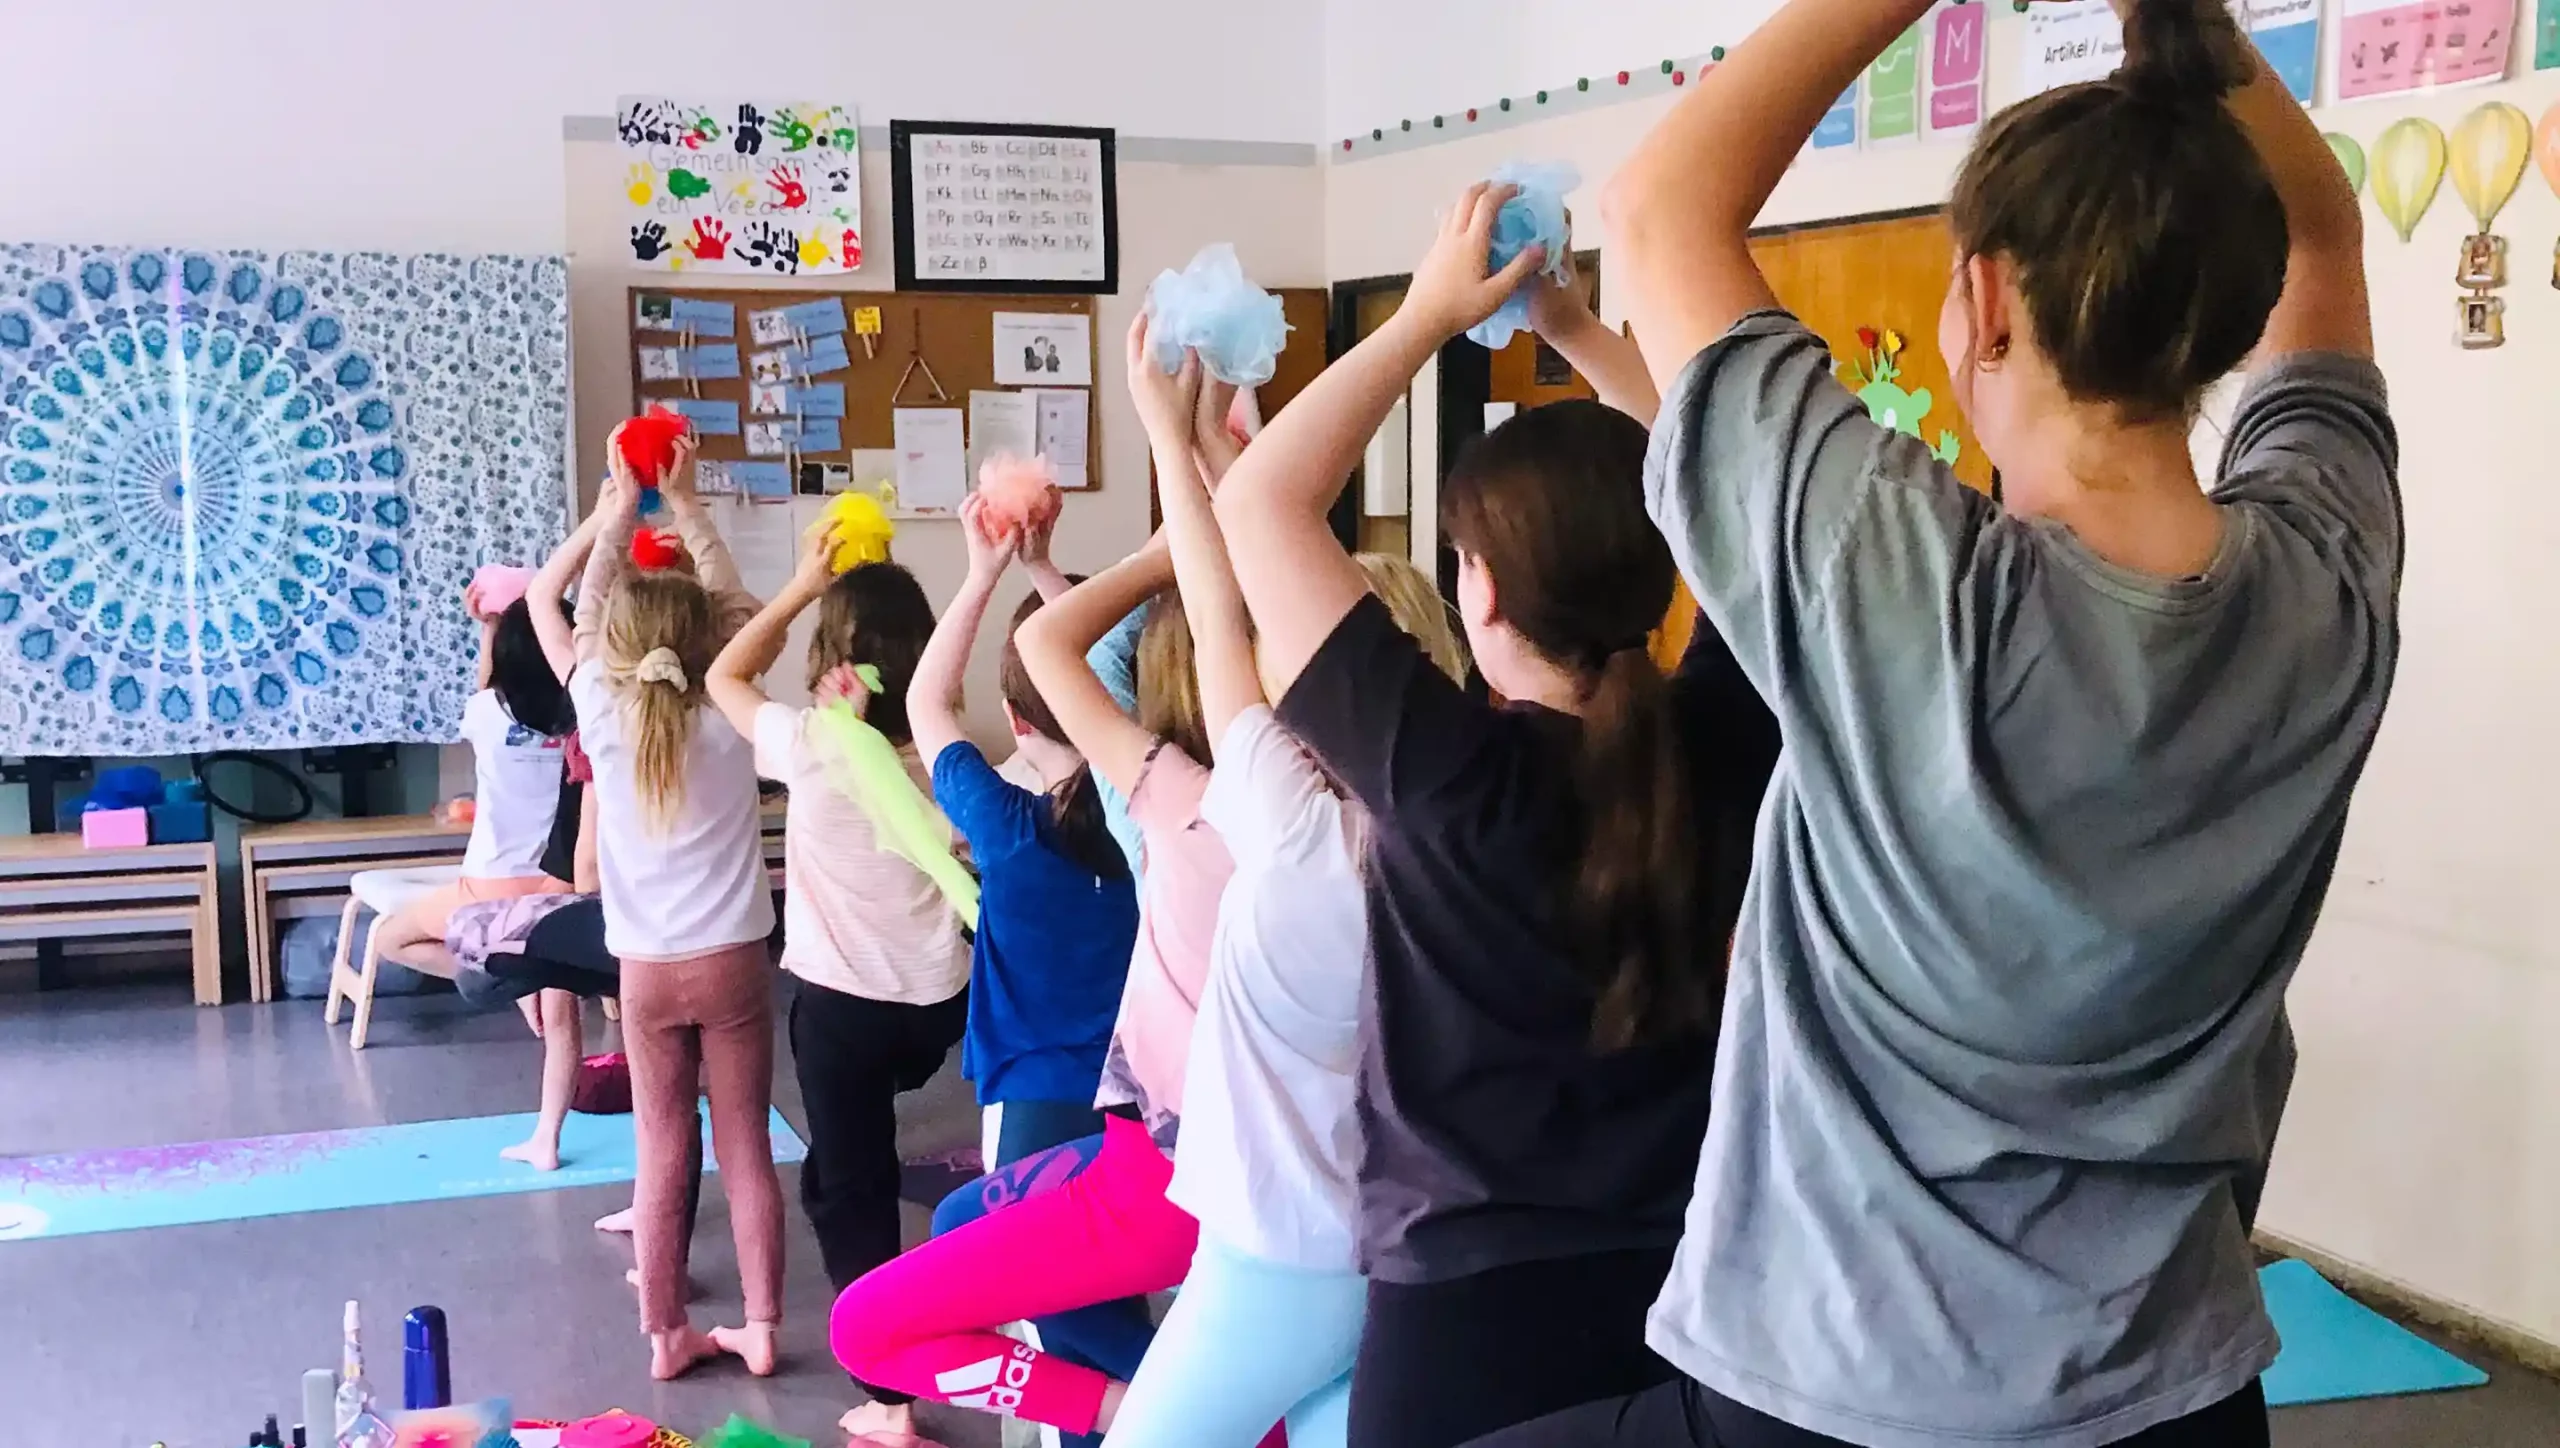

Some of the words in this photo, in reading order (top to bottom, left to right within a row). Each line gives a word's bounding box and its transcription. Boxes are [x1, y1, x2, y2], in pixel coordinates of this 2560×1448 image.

[1944, 18, 1972, 67] M
[2044, 37, 2088, 64] Artikel
[650, 144, 807, 173] Gemeinsam
[712, 186, 813, 214] Veede!
